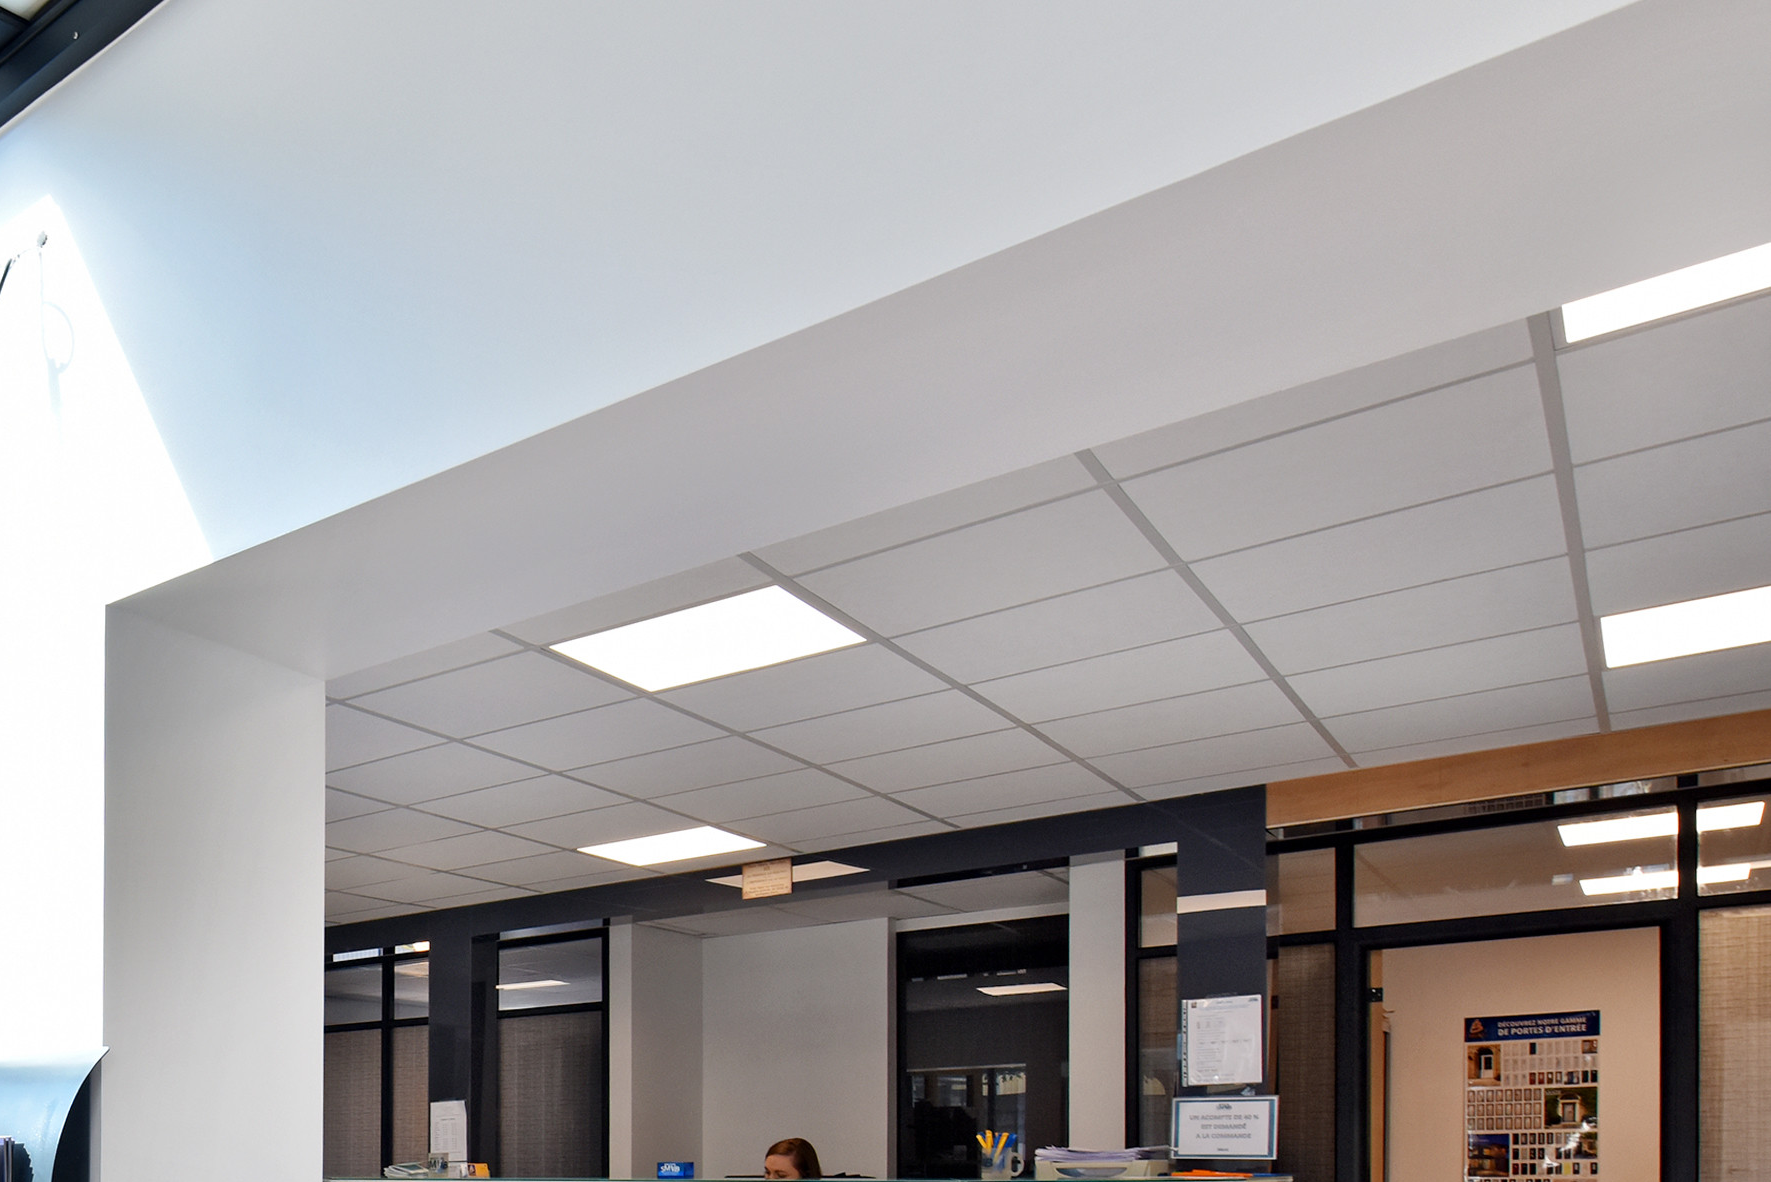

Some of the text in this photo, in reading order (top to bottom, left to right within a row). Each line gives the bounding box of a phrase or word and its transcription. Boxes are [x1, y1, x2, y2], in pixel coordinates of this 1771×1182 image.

[1497, 1023, 1587, 1037] DE PORTES D'ENTRÉE
